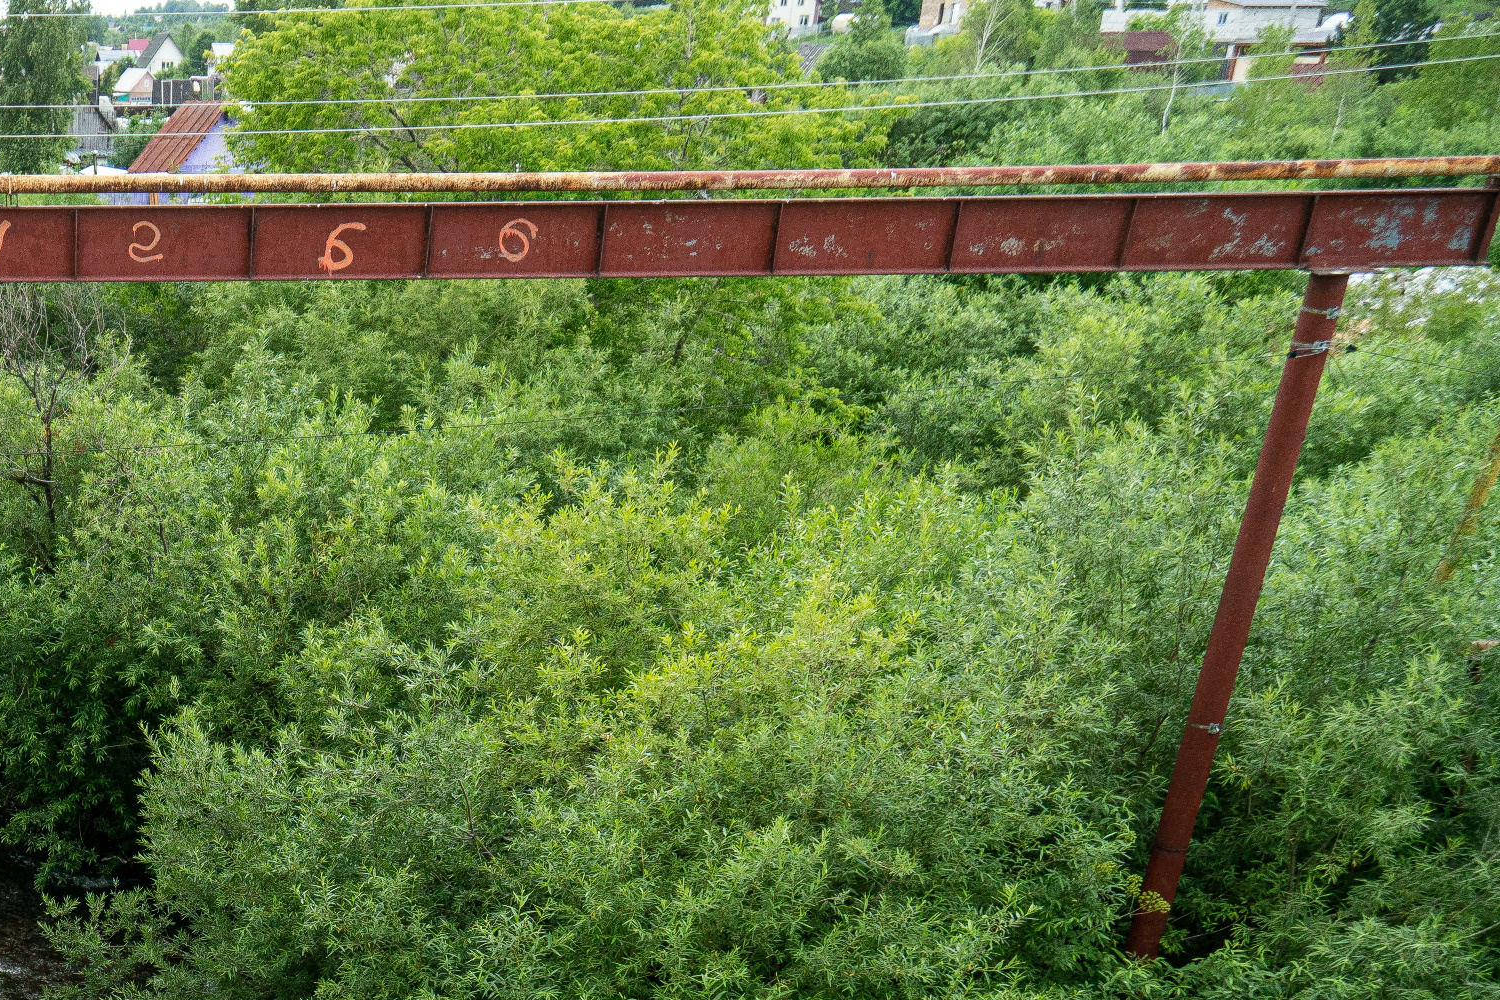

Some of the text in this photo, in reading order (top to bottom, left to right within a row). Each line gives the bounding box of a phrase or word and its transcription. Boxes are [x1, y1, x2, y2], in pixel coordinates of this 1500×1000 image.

[129, 221, 162, 260] 2
[319, 222, 366, 273] 6
[500, 218, 537, 260] 6
